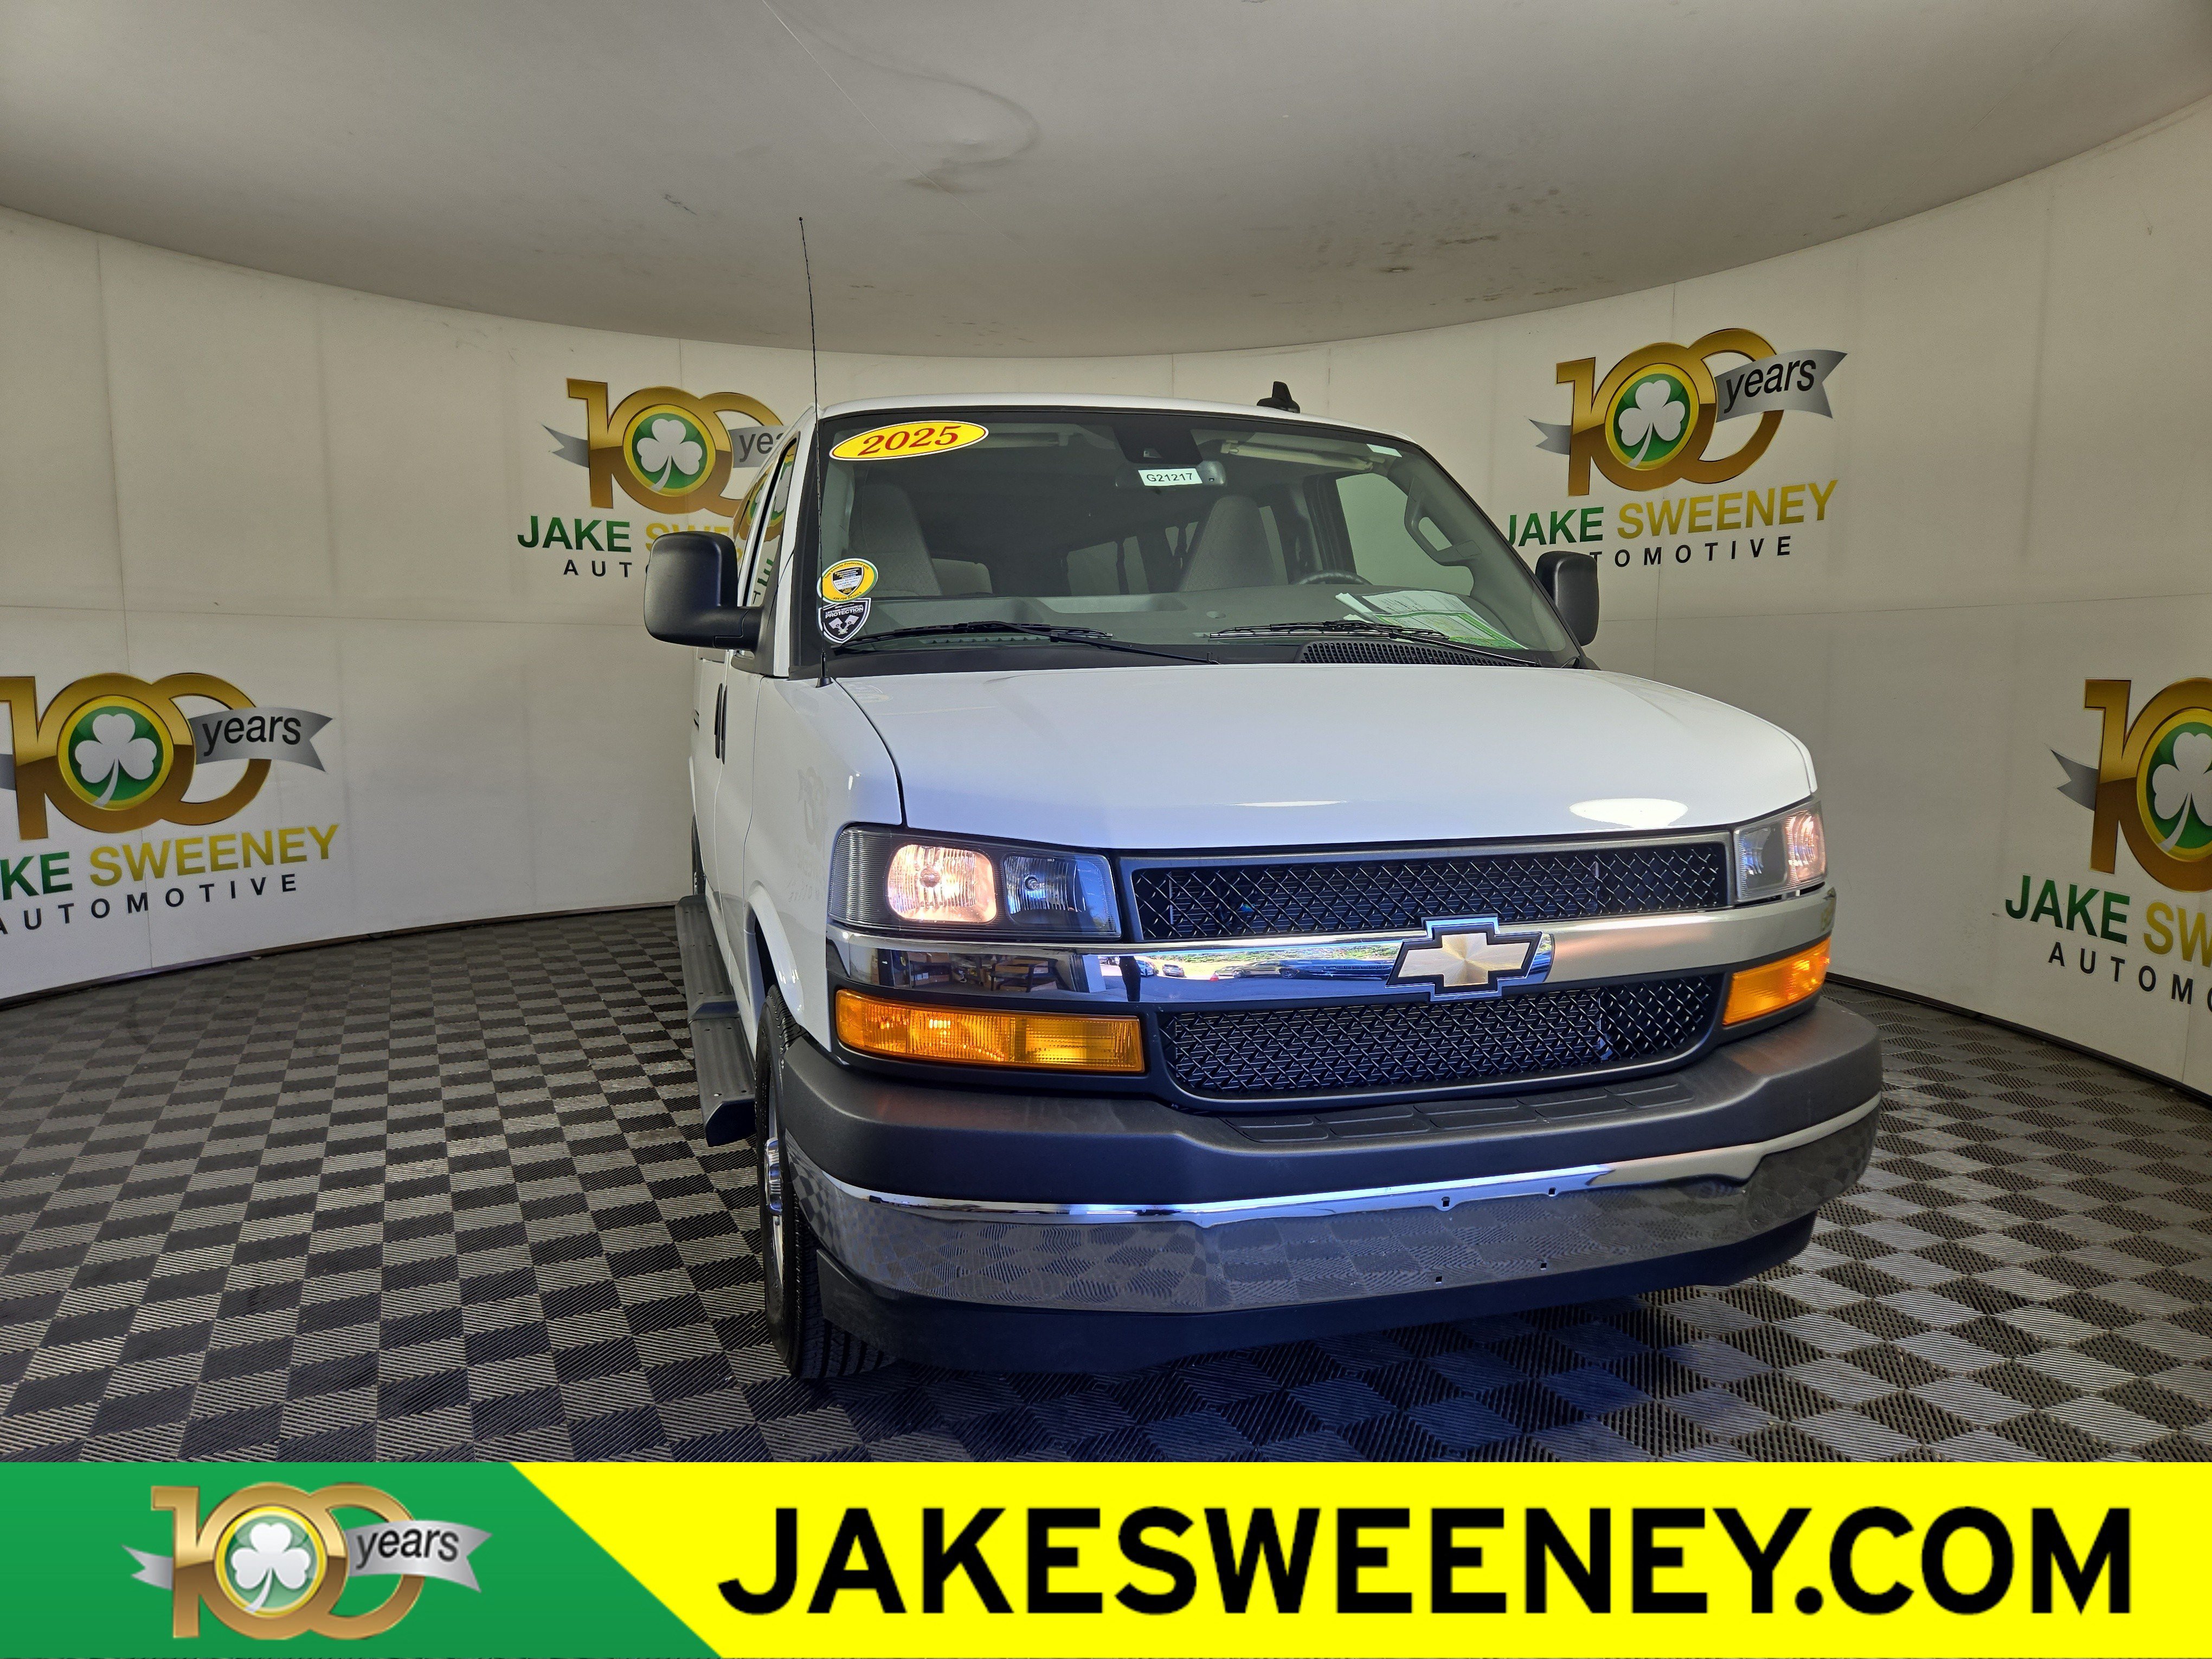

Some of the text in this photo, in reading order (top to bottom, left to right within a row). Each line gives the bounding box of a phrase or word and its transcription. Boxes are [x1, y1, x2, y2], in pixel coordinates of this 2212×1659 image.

[1724, 357, 1817, 413] years
[857, 426, 962, 456] 2025
[1146, 473, 1192, 482] G21217
[1617, 480, 1838, 539] SWEENEY
[517, 515, 632, 553] JAKE
[1589, 536, 1792, 568] TOMOTIVE
[563, 559, 648, 578] AUT
[825, 606, 864, 619] PROTECTION
[202, 713, 302, 756] years
[89, 824, 339, 888] SWEENEY
[2005, 874, 2130, 945] JAKE
[2048, 941, 2212, 1013] AUTOM
